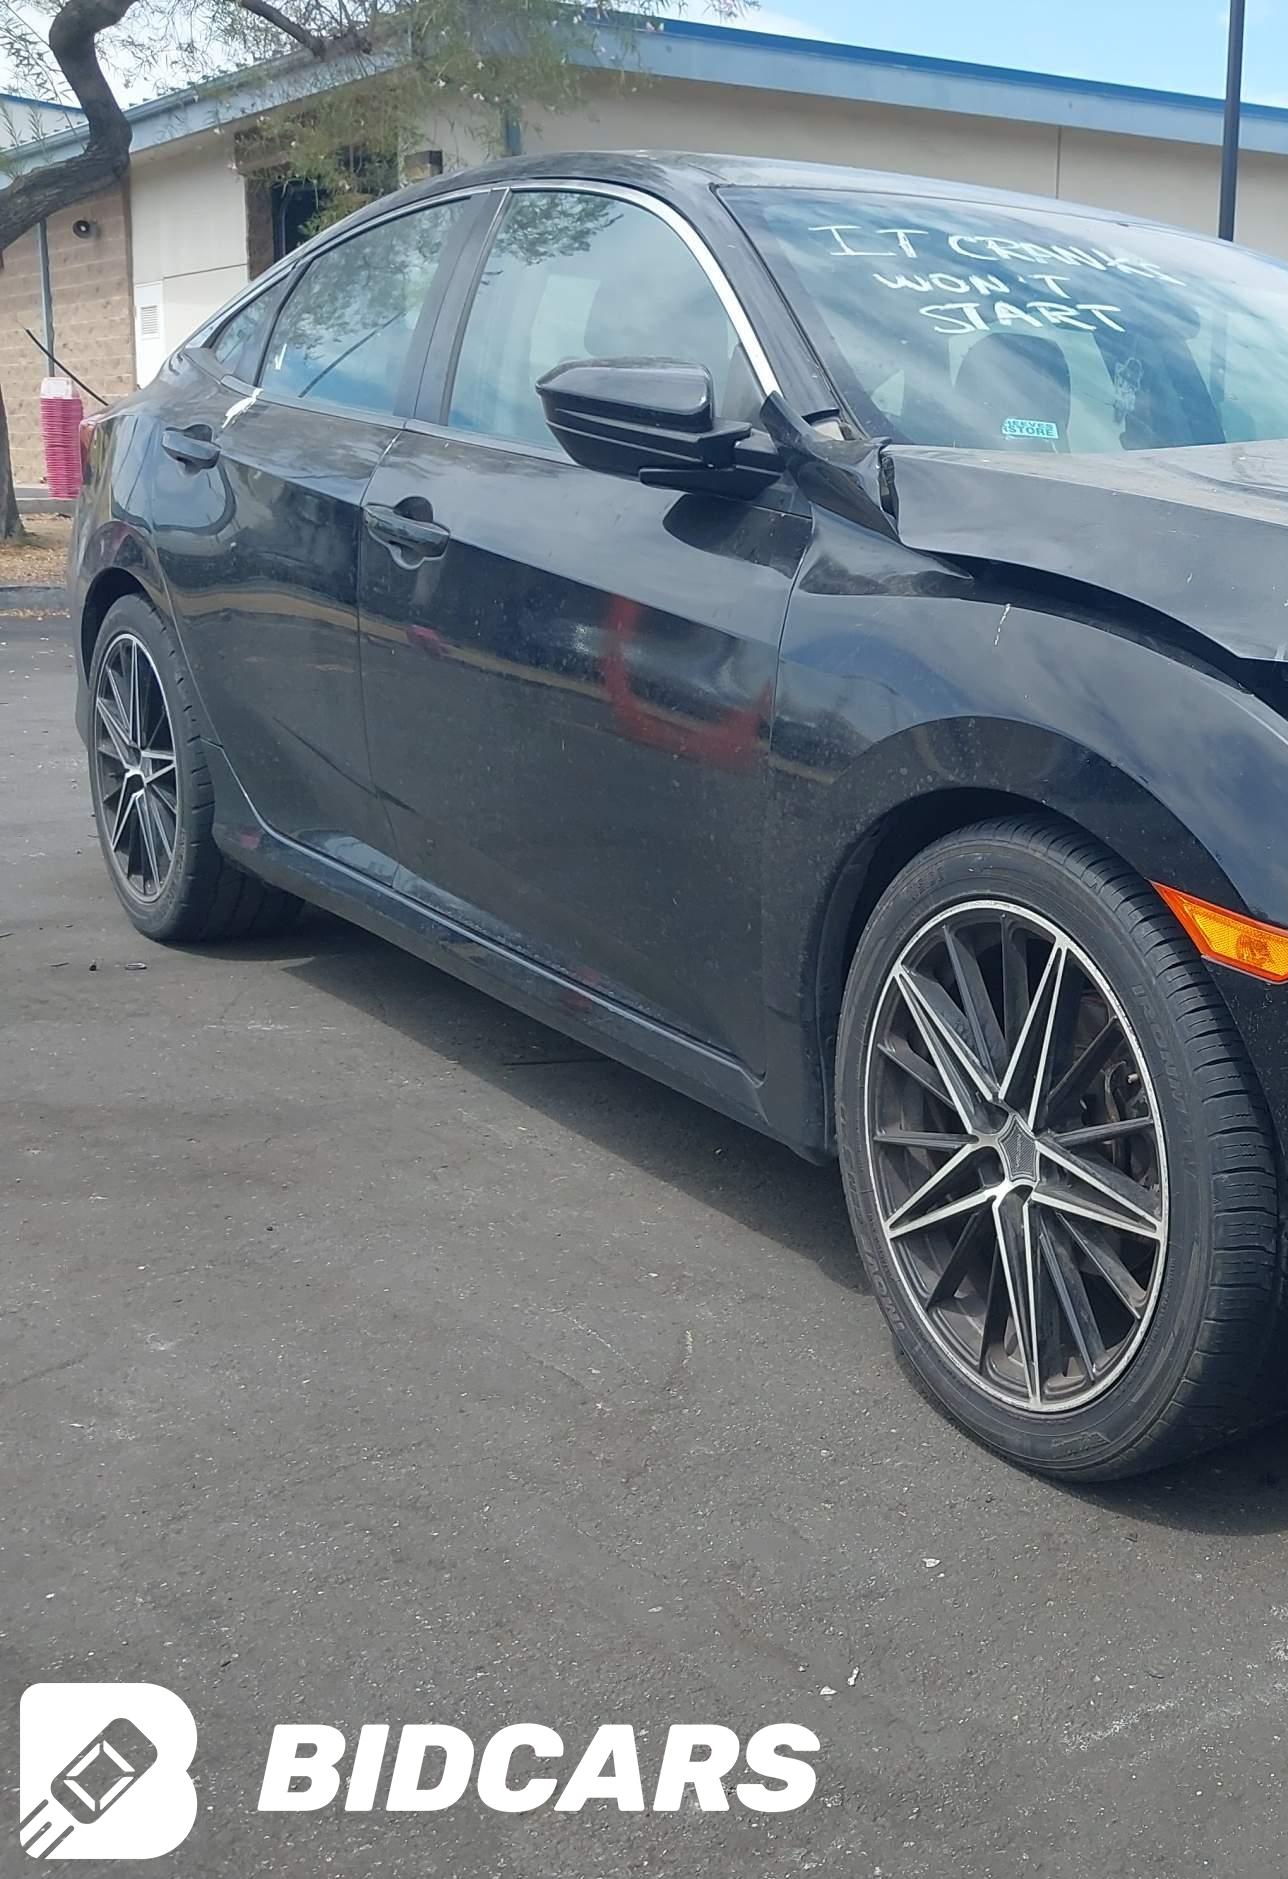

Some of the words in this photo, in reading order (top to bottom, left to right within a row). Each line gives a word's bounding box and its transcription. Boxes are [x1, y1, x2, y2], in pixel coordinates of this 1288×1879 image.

[808, 225, 929, 258] IT
[873, 273, 1071, 299] WON'T
[919, 302, 1126, 334] START
